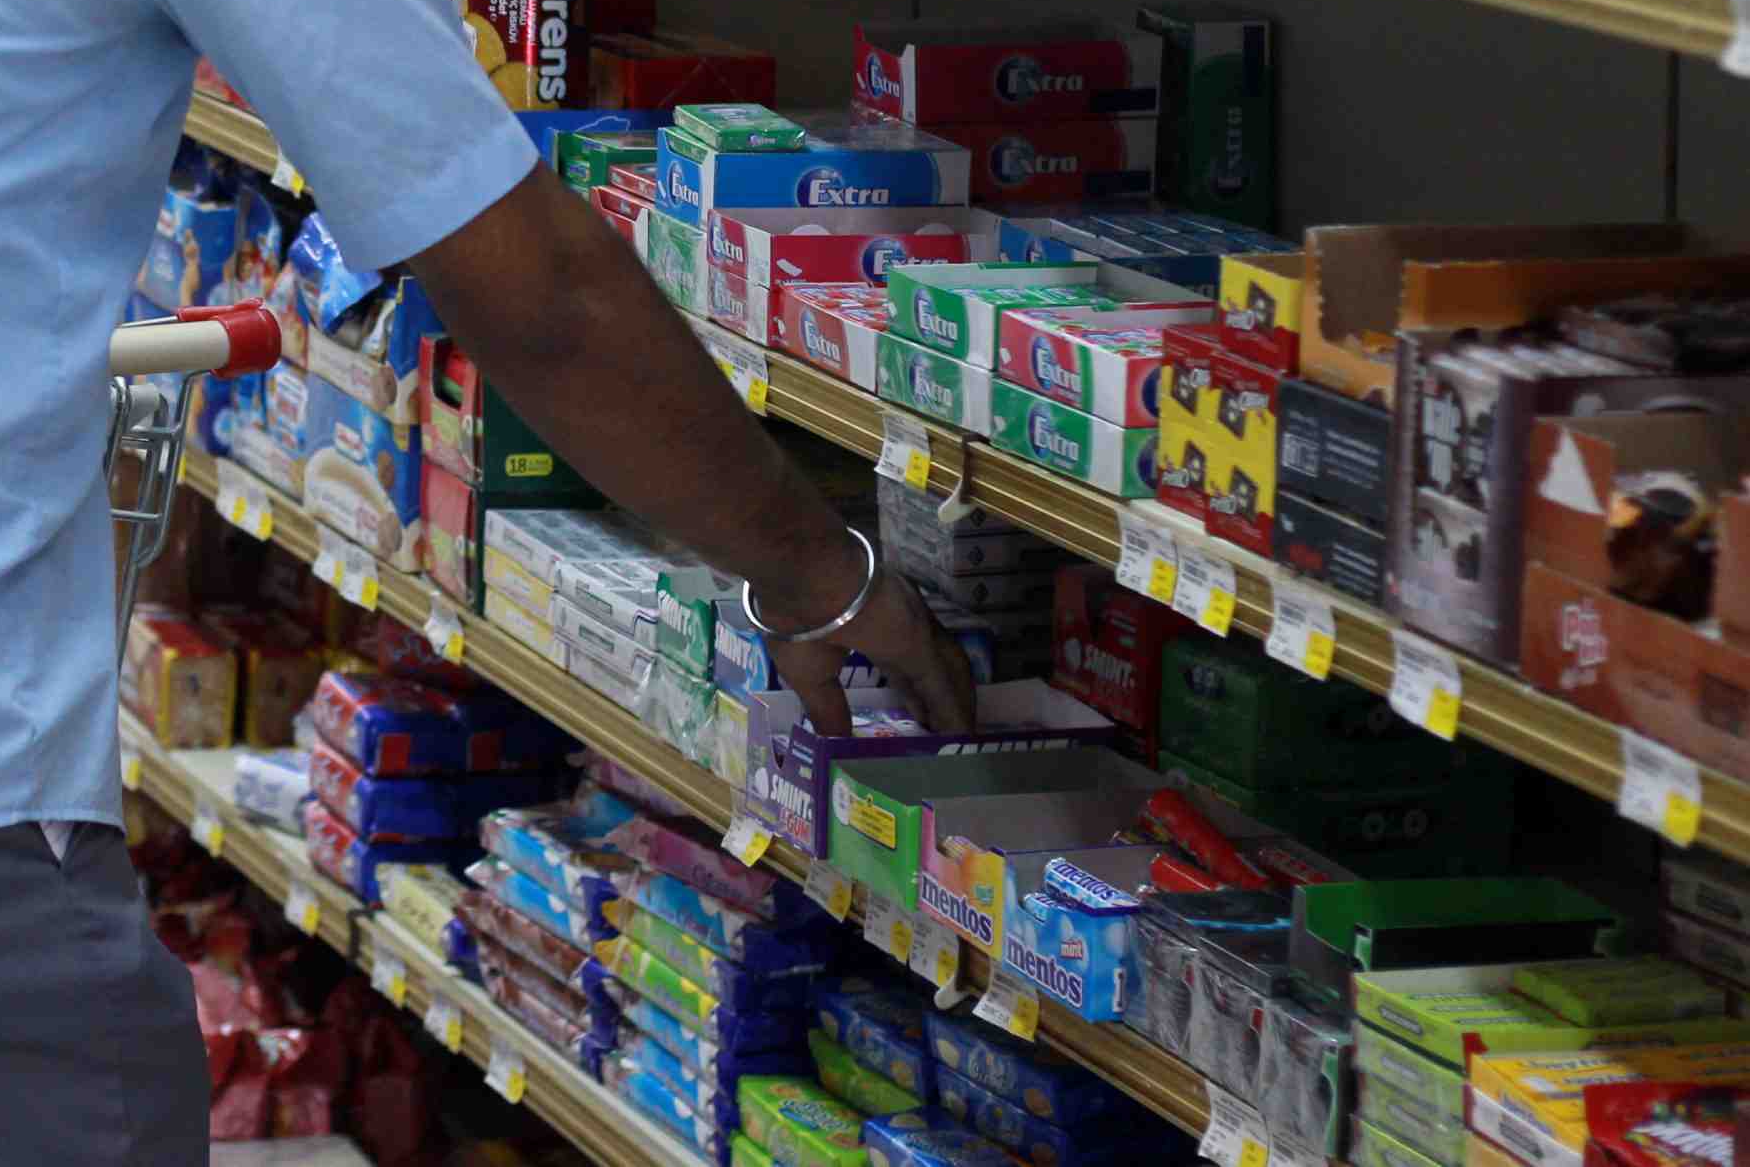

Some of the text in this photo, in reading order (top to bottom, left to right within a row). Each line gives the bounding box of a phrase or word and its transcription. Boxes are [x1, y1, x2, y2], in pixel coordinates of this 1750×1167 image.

[870, 65, 901, 98] Extra
[1006, 68, 1084, 95] Extra
[1000, 147, 1079, 175] Extra
[671, 171, 699, 206] Extra
[808, 178, 891, 207] Extra
[712, 227, 745, 260] Extra
[917, 297, 959, 341] Extra
[803, 318, 841, 363] Extra
[1036, 348, 1083, 394] Extra
[1033, 413, 1080, 462] Extra
[508, 457, 527, 474] 18
[1053, 860, 1118, 903] mentos
[921, 872, 994, 946] mentos
[1005, 933, 1083, 1009] mentos
